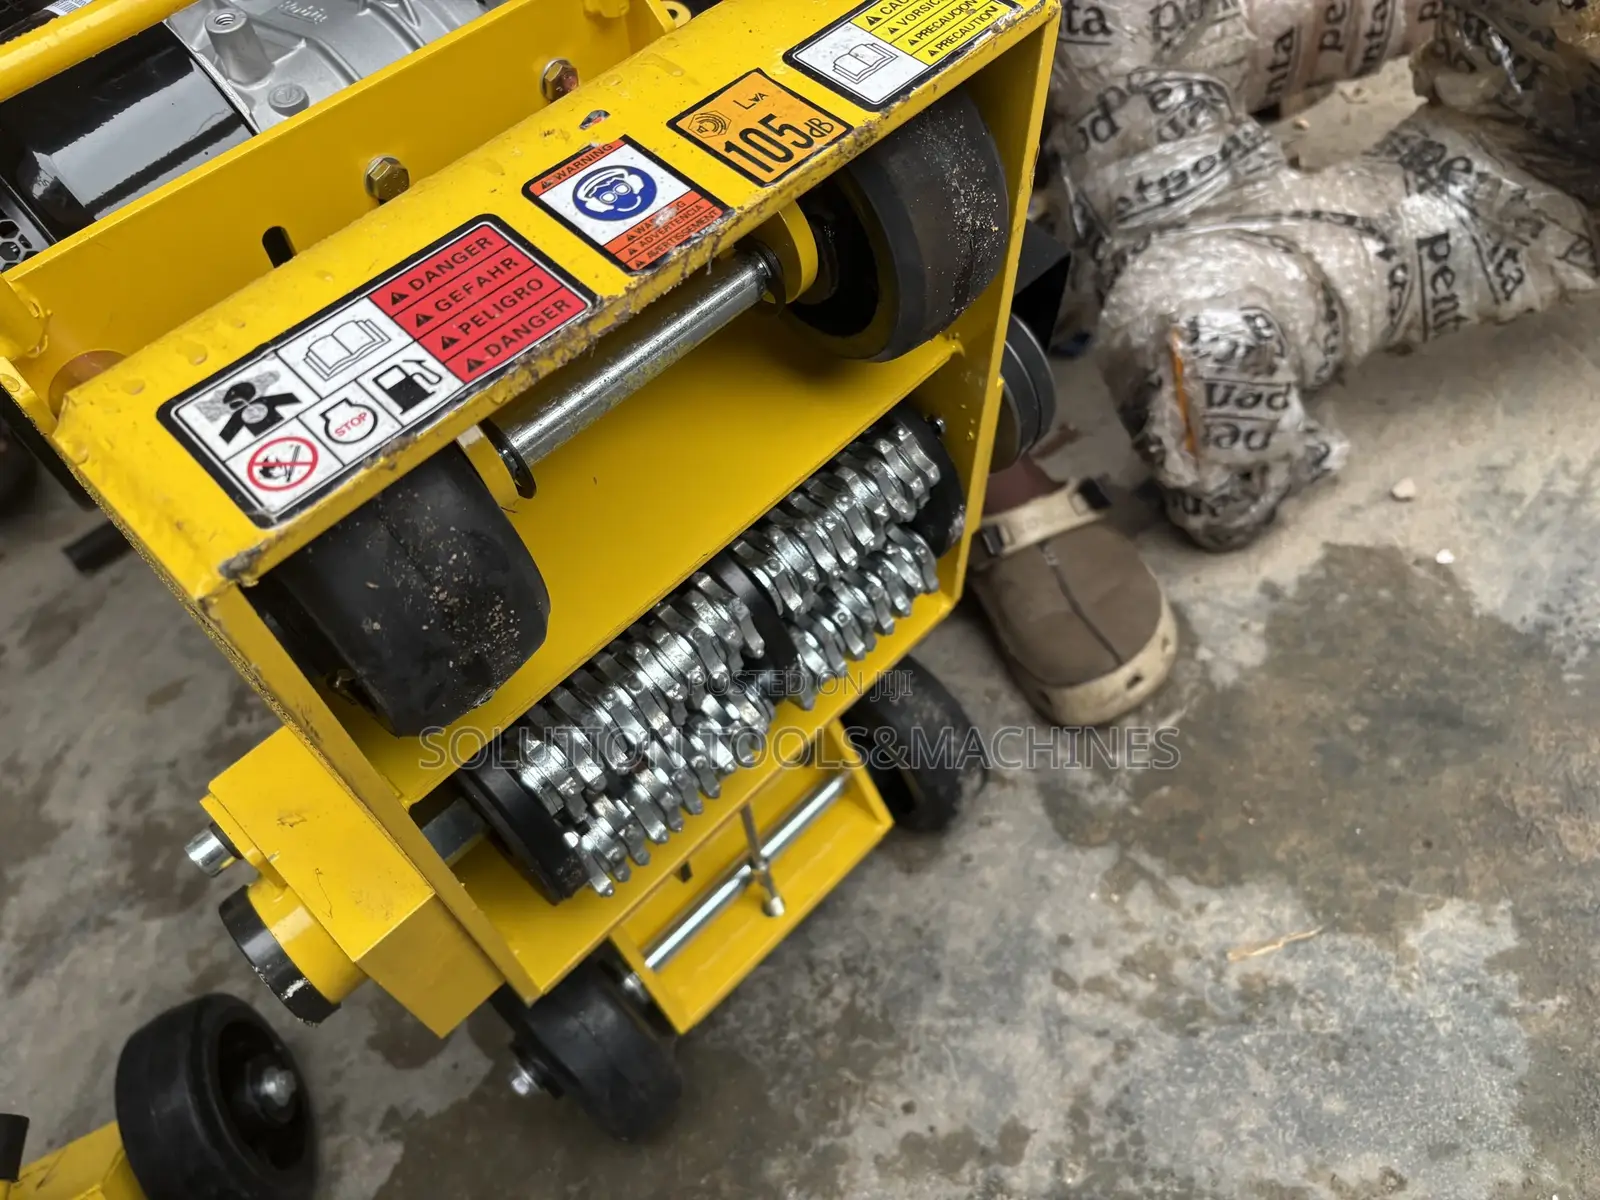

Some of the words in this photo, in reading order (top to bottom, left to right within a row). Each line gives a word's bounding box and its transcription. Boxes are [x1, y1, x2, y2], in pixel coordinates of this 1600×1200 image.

[935, 5, 999, 51] PRECAUTION
[554, 143, 613, 181] WARNING
[640, 204, 705, 247] ADVERTENCIA
[647, 209, 718, 258] AVERTISSEMENT
[408, 236, 493, 291] DANGER
[434, 256, 519, 313] GEFAHR
[458, 278, 543, 336] PELIGRO
[484, 299, 571, 358] DANGER
[335, 412, 367, 437] STOP
